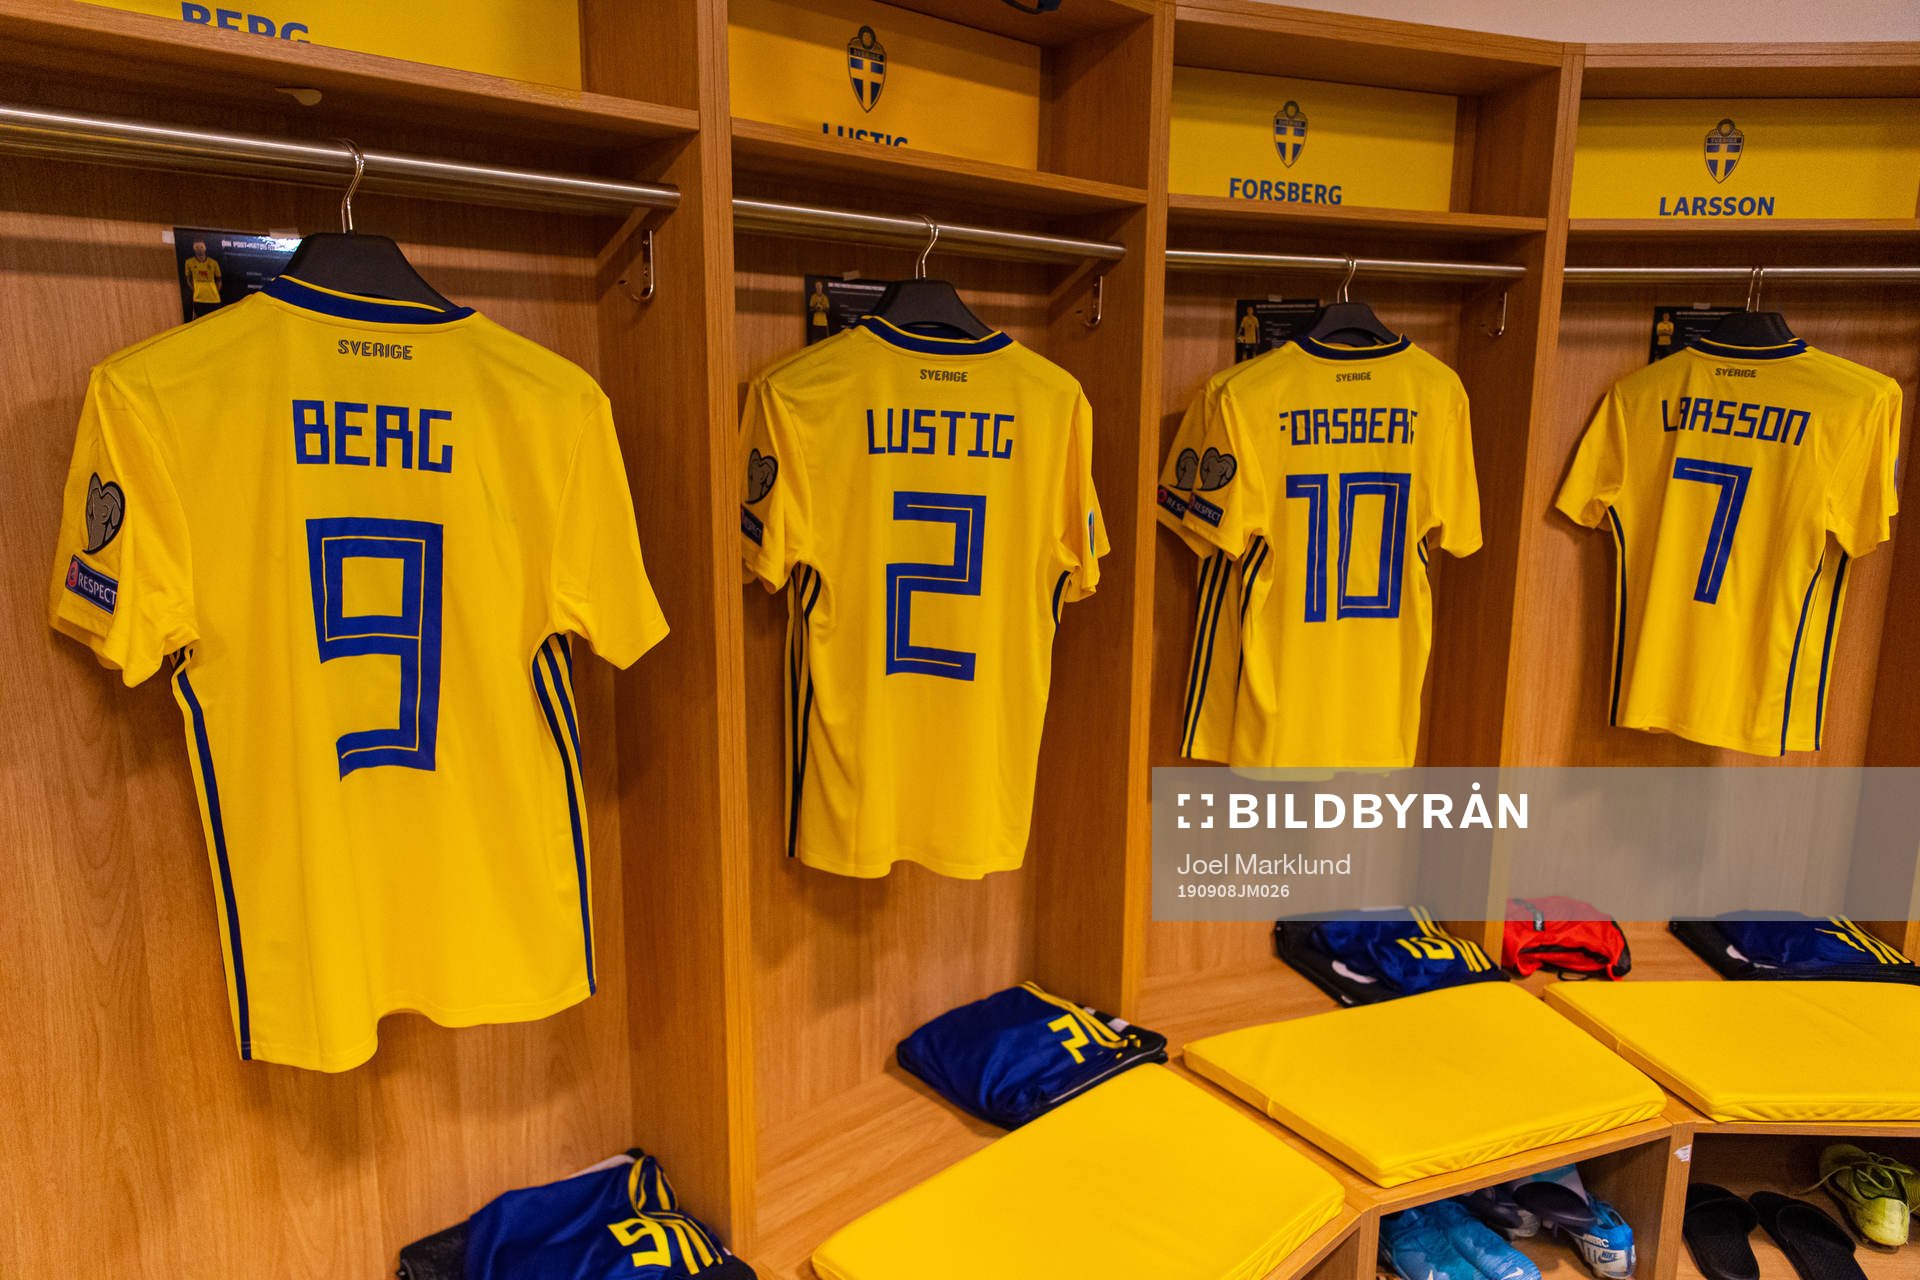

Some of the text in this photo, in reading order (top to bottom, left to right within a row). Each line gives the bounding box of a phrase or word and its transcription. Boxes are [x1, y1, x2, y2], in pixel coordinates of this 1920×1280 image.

[1229, 177, 1342, 205] FORSBERG
[1659, 196, 1775, 216] LARSSON
[337, 339, 414, 360] SVERIGE
[1715, 367, 1757, 378] SVERIGE
[919, 368, 968, 383] SVERIGE
[1335, 371, 1372, 382] SVERIGE
[292, 398, 454, 474] BERG
[866, 407, 1015, 460] LUSTIG
[1661, 397, 1811, 446] LARSSON
[1285, 472, 1412, 623] 10
[1672, 457, 1753, 605] 7
[78, 572, 117, 606] RESPECT
[886, 490, 987, 682] 2
[304, 516, 444, 782] 9
[607, 1217, 672, 1268] 9
